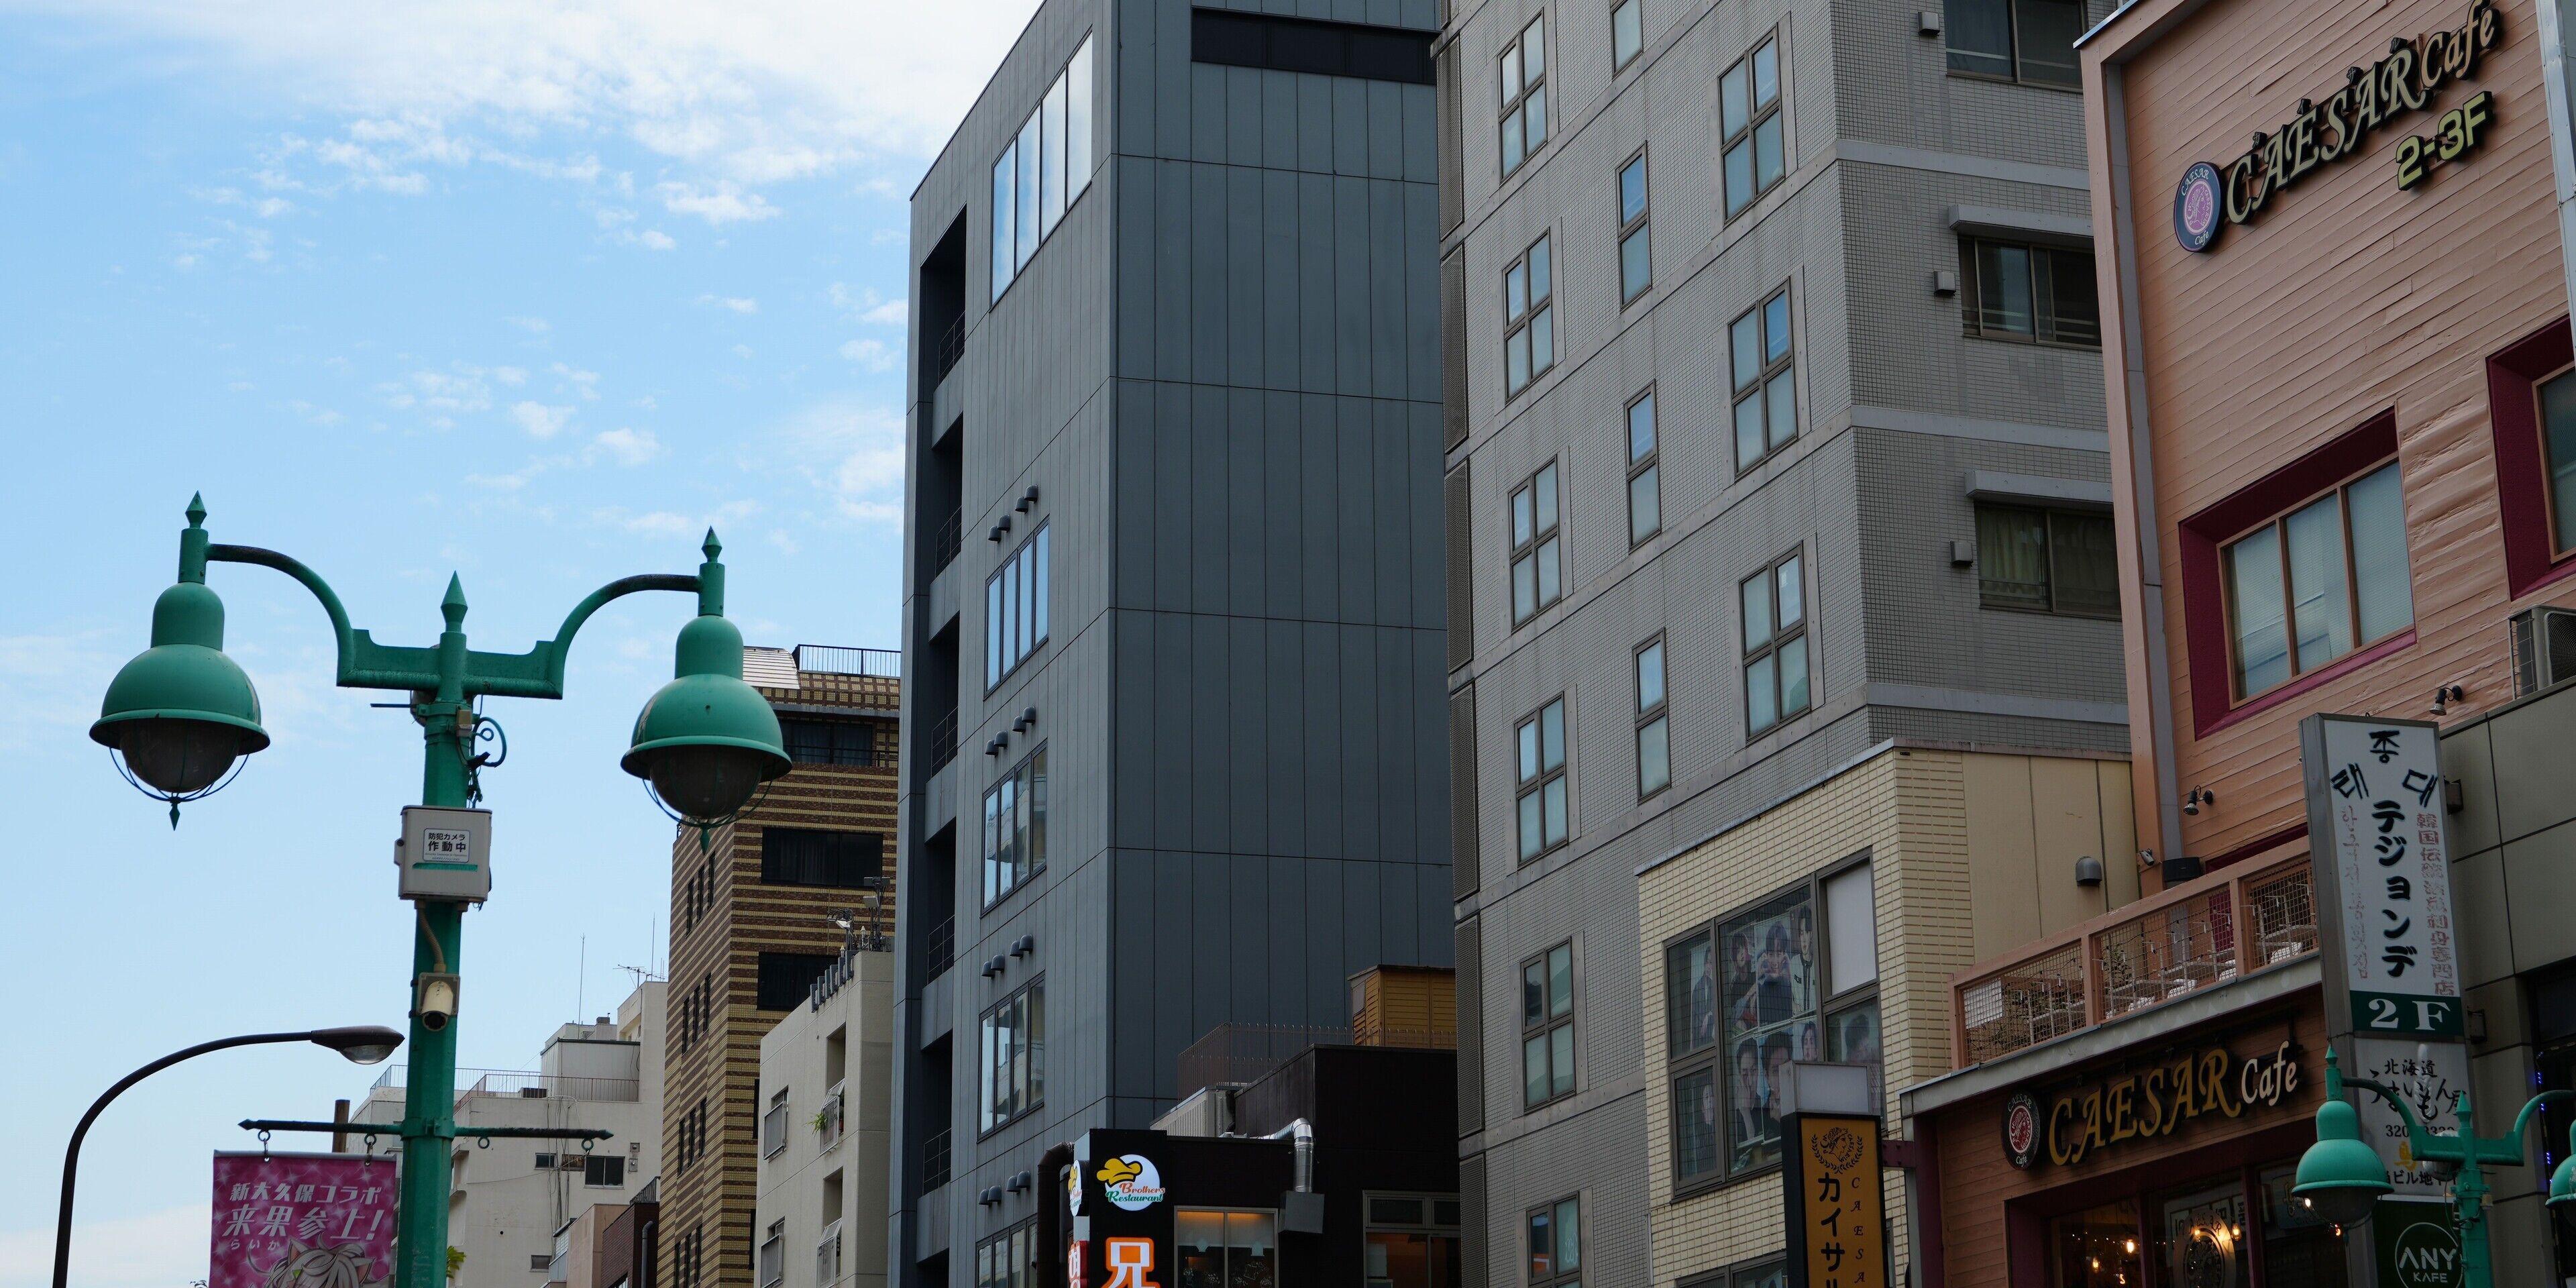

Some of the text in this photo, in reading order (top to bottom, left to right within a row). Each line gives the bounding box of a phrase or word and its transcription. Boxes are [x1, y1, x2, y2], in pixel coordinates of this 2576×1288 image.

[2226, 0, 2500, 225] CAESAR Cafe
[2396, 91, 2491, 191] 2-3F
[2181, 168, 2209, 196] CAESAR
[2194, 229, 2210, 246] Cafe
[428, 833, 466, 841] 防犯カメラ
[428, 841, 466, 853] 作動中
[2371, 800, 2417, 978] テジョンデ
[2383, 1058, 2438, 1077] 北海道
[2049, 1049, 2241, 1167] CAESAR
[2241, 1040, 2298, 1107] Cafe
[229, 1181, 382, 1205] 新大久保コラボ
[1106, 1189, 1164, 1203] Restaurant
[1119, 1182, 1166, 1194] Brothers
[222, 1203, 384, 1240] 来果参上!
[231, 1239, 280, 1251] らいか
[2399, 1246, 2457, 1271] ANY
[2413, 1271, 2448, 1283] KAFE
